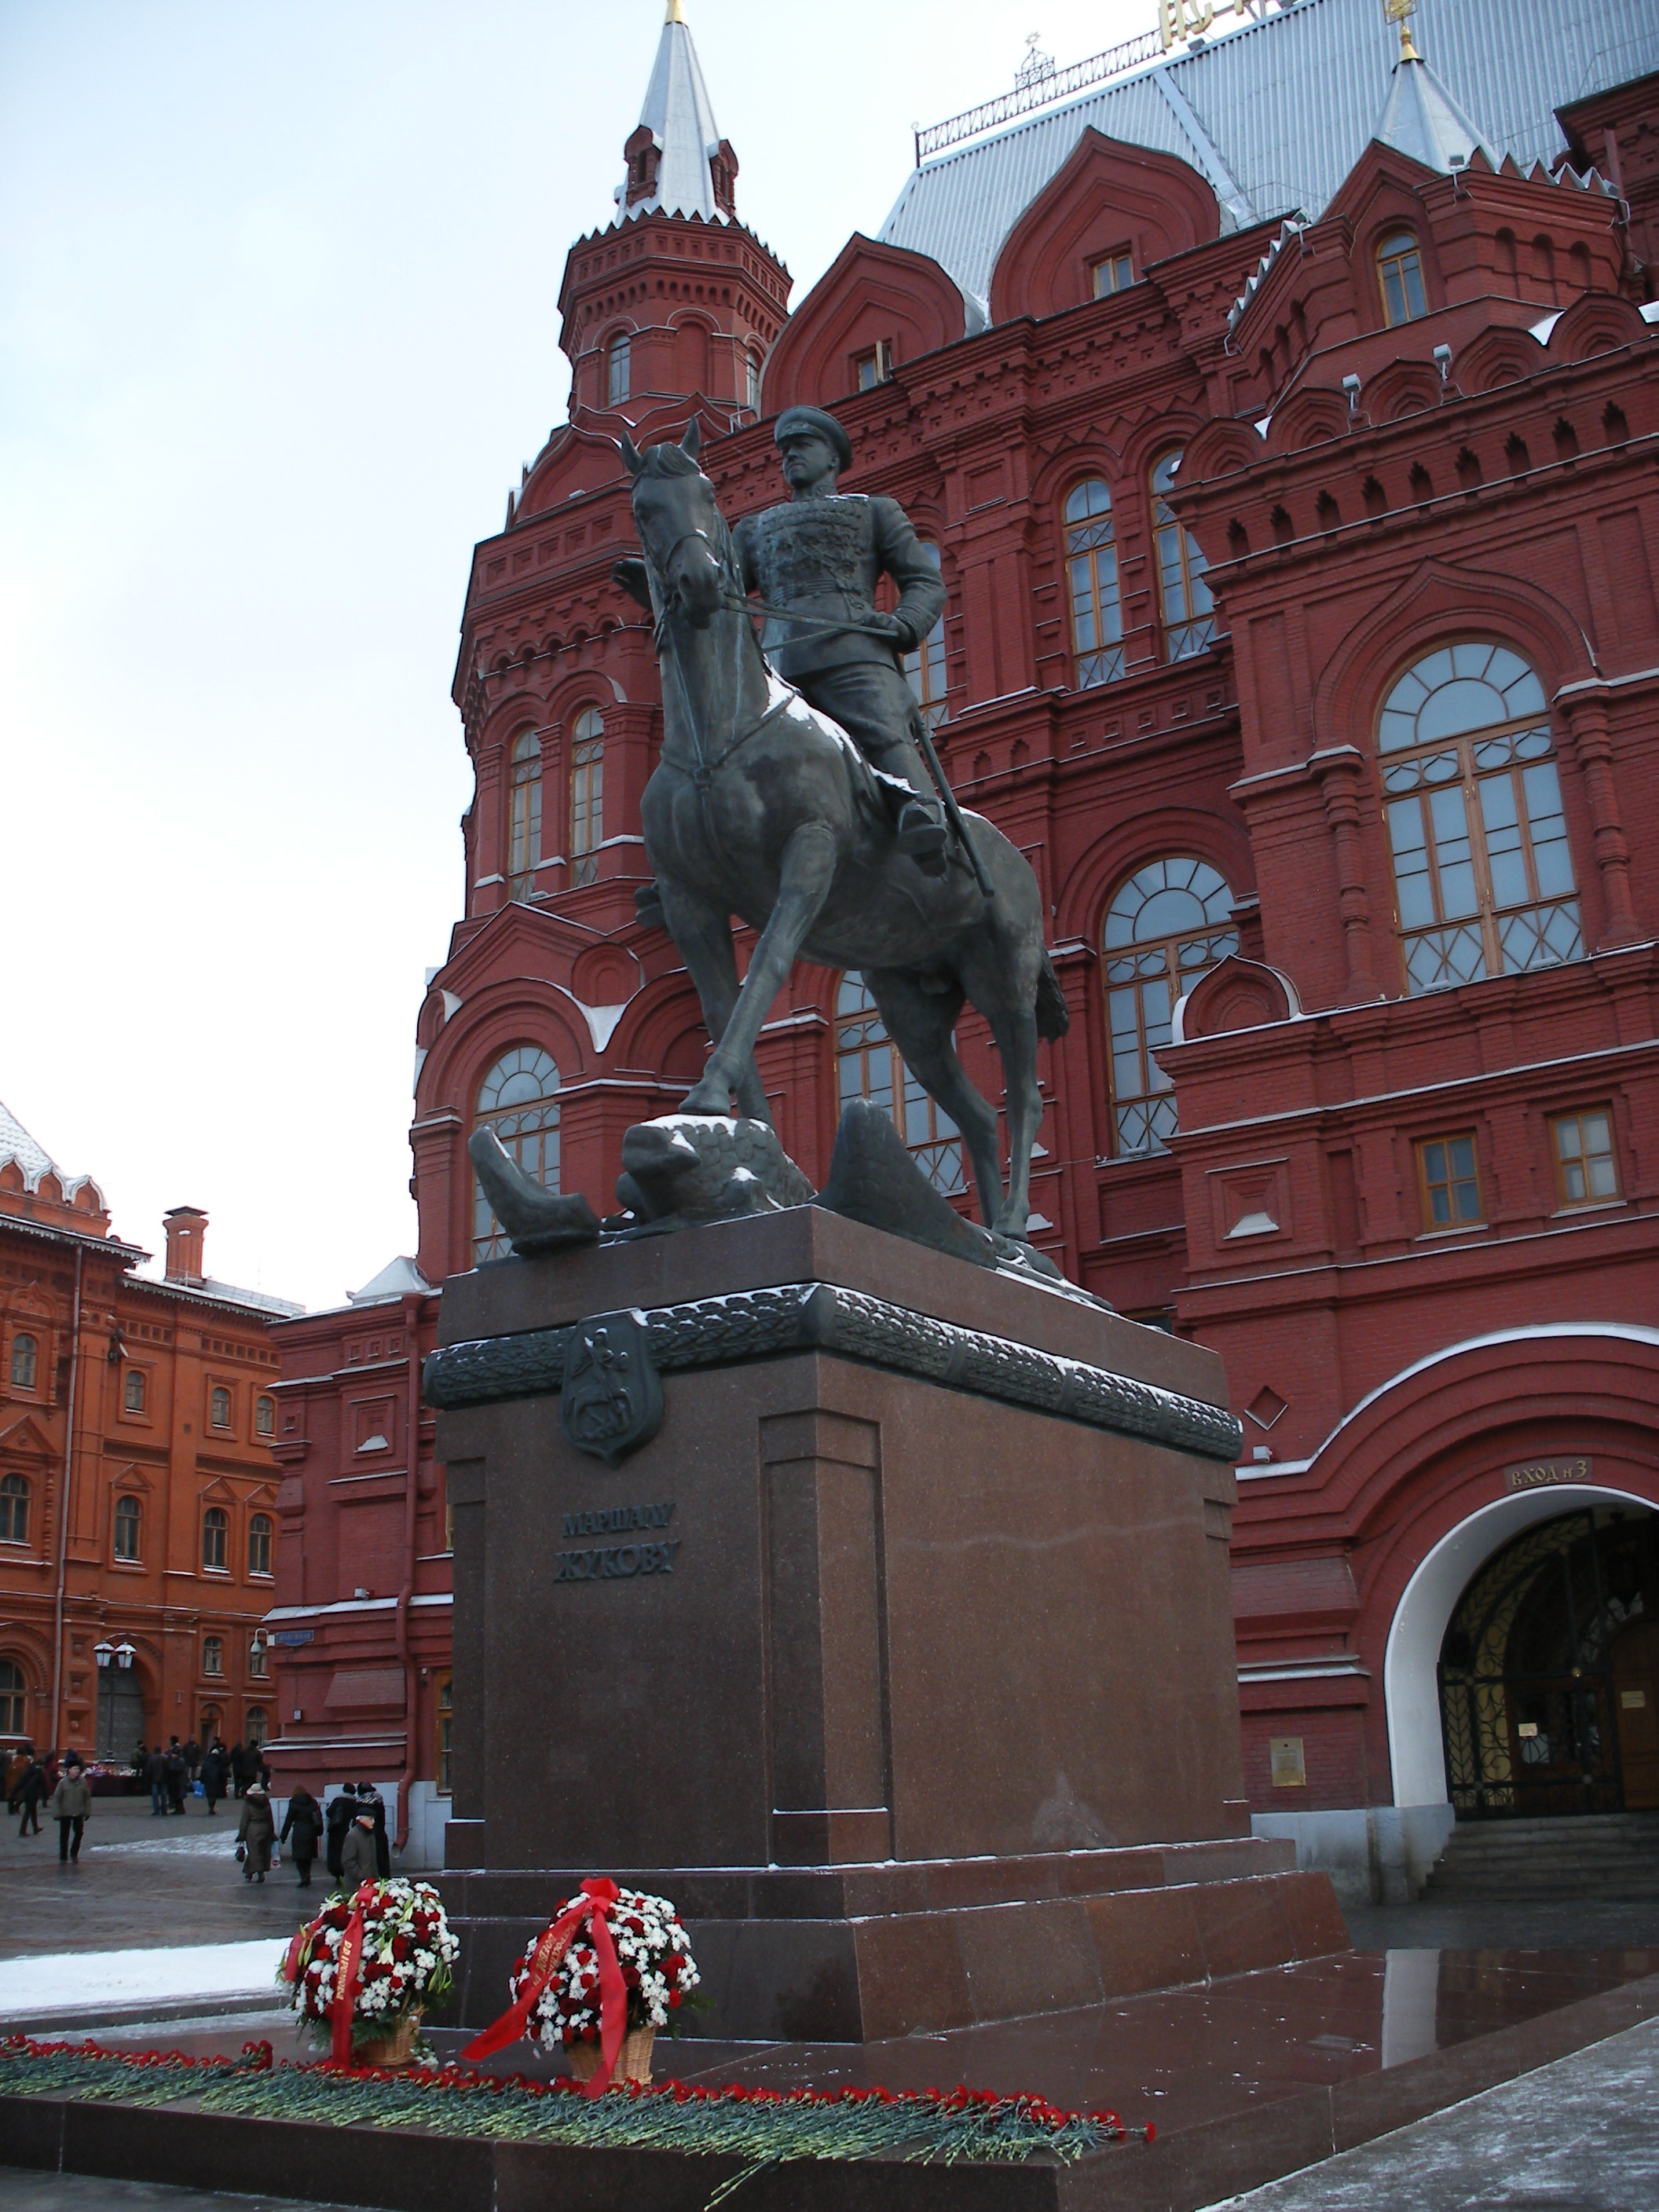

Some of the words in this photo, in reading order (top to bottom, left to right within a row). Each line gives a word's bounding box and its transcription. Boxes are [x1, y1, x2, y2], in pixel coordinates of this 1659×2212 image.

[1511, 1465, 1559, 1486] ВХОД
[1577, 1459, 1588, 1478] 3
[562, 1502, 676, 1538] МАРШАЛУ
[553, 1540, 682, 1583] ЖУКОВУ
